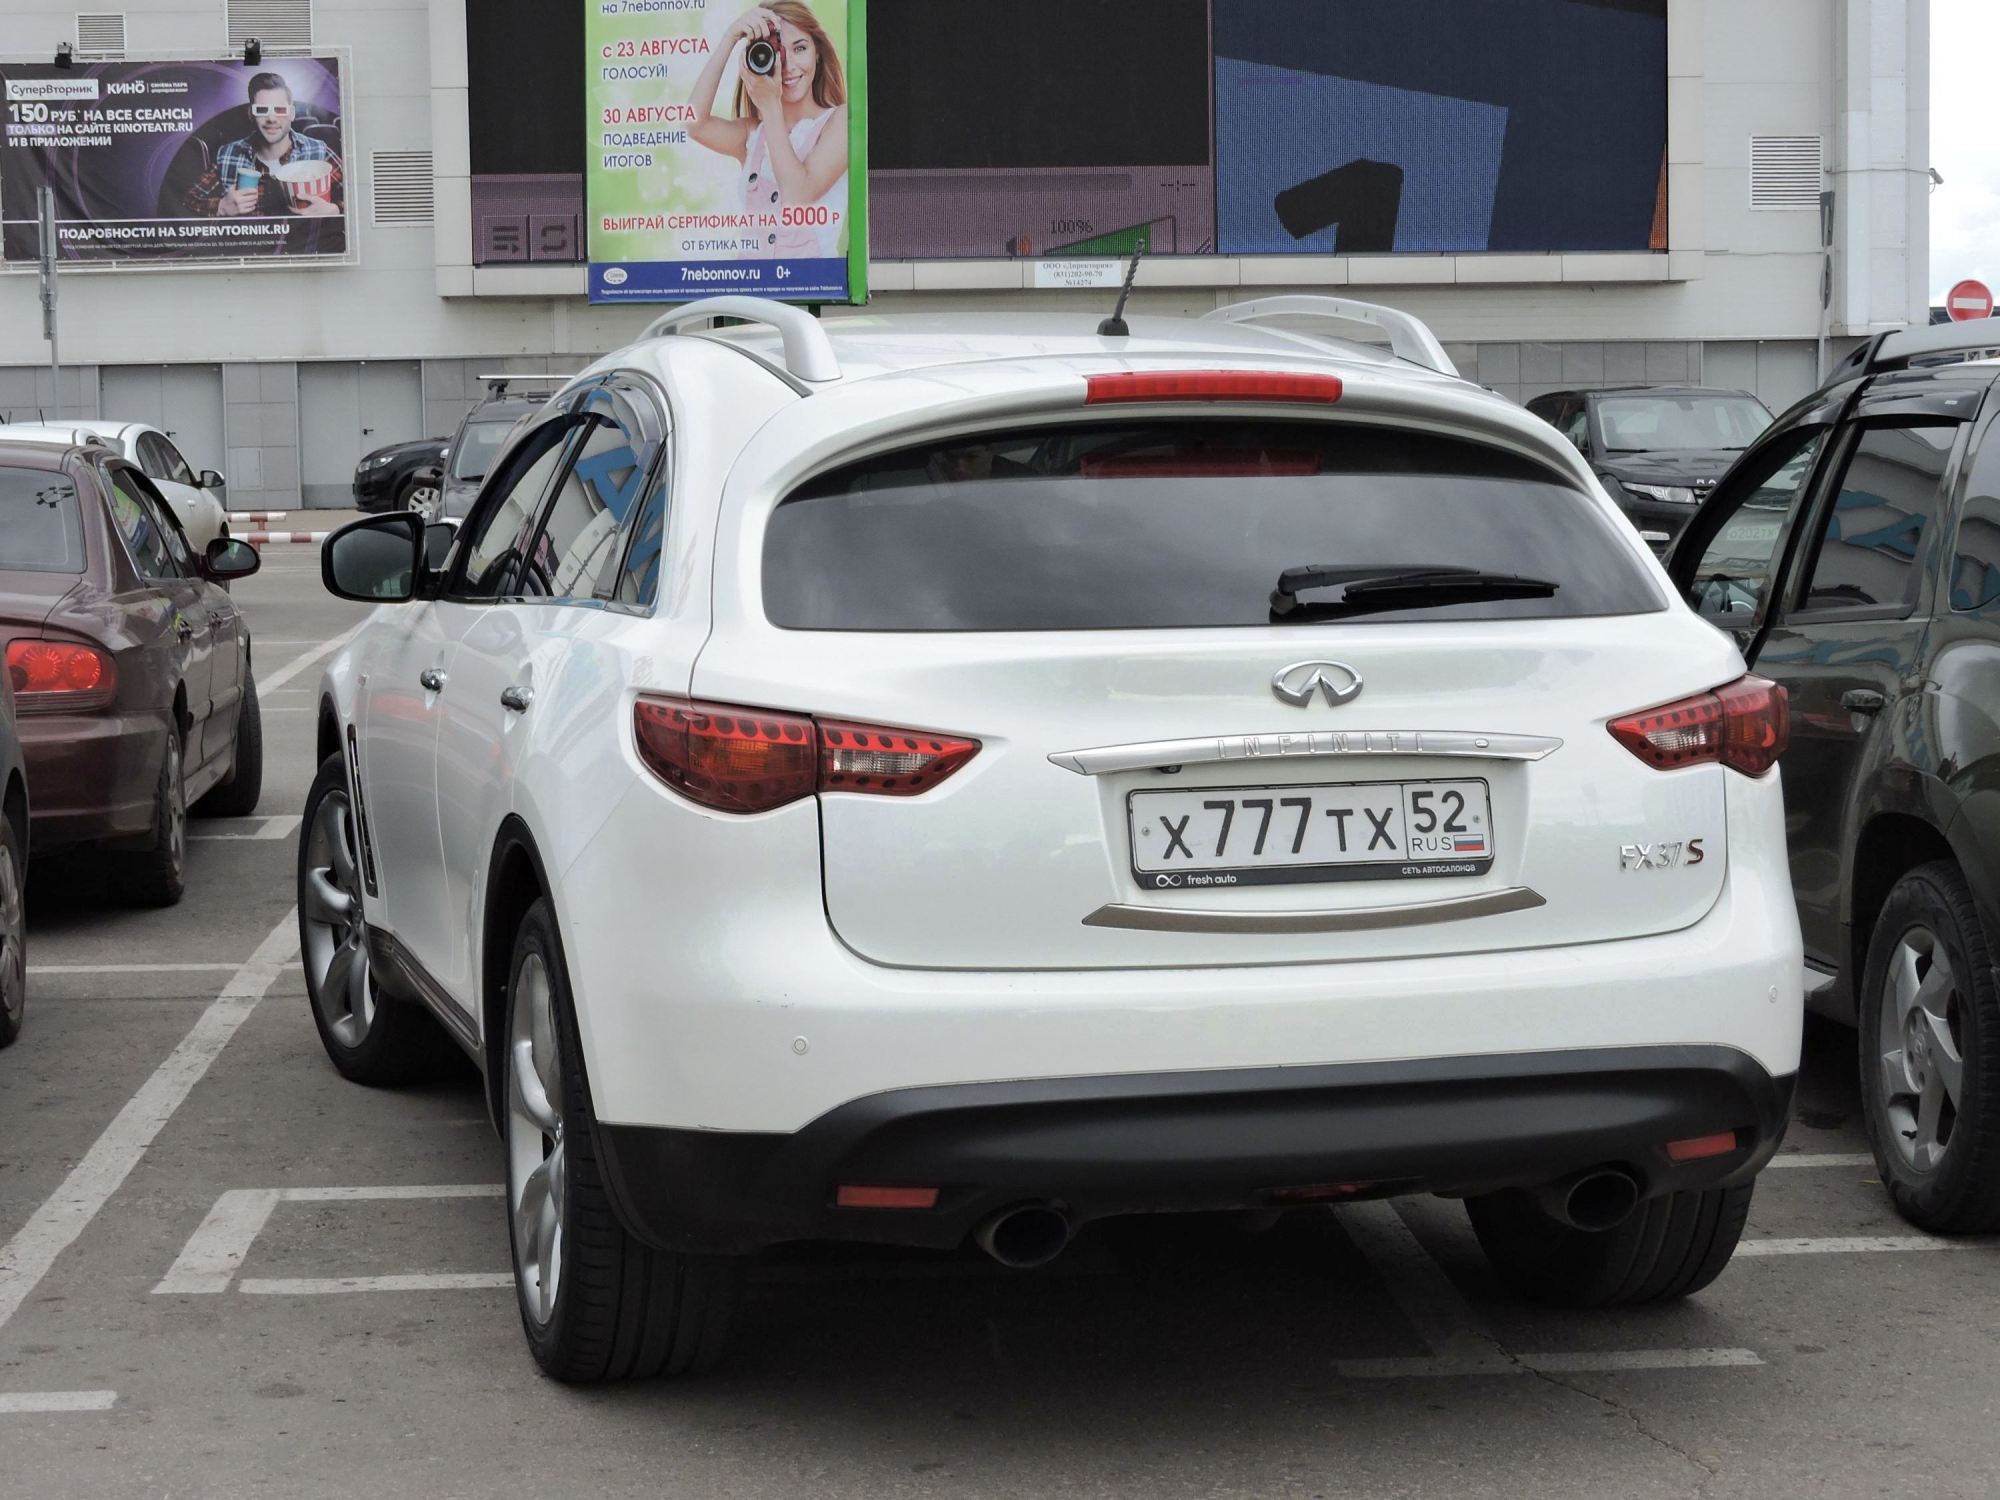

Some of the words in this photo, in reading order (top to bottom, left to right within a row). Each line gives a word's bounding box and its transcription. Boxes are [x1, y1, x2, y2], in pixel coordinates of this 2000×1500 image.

[602, 3, 618, 14] на
[617, 41, 635, 57] 23
[640, 38, 710, 56] АВГУСТА
[603, 64, 668, 81] ГОЛОСУЙ!
[11, 83, 94, 97] СуперВторник
[8, 103, 49, 123] 150
[84, 110, 103, 122] НА
[106, 109, 133, 121] ВСЕ
[135, 108, 193, 121] СЕАНСЫ
[603, 107, 621, 124] 30
[626, 105, 696, 123] АВГУСТА
[8, 124, 56, 135] ТОЛЬКО
[57, 124, 74, 134] НА
[75, 121, 112, 134] САЙТЕ
[113, 122, 193, 133] KINOTEATR.RU
[9, 138, 19, 147] И
[20, 138, 28, 147] В
[30, 136, 112, 147] ПРИЛОЖЕНИИ
[603, 131, 687, 148] ПОДВЕДЕНИЕ
[603, 154, 653, 168] ИТОГОВ
[603, 213, 664, 231] ВЫИГРАЙ
[667, 214, 755, 230] СЕРТИФИКАТ
[758, 214, 778, 227] НА
[781, 206, 828, 226] 5000
[1050, 219, 1093, 234] 100%
[59, 227, 156, 240] ПОДРОБНОСТИ
[158, 226, 177, 238] НА
[179, 224, 290, 237] SUPERVTORNIK.RU
[681, 240, 696, 251] ОТ
[698, 239, 738, 251] БУТИКА
[740, 239, 759, 251] ТРЦ
[681, 267, 761, 281] 7nebonnov.ru
[776, 265, 791, 279] 0+
[1217, 733, 1424, 759] INFINITI
[1411, 790, 1467, 833] 52
[1411, 836, 1453, 852] RUS
[1402, 867, 1421, 875] СЕТЬ
[1422, 864, 1476, 874] АВТОСАЛОНОВ
[1187, 875, 1213, 885] fresh
[1214, 874, 1237, 884] auto
